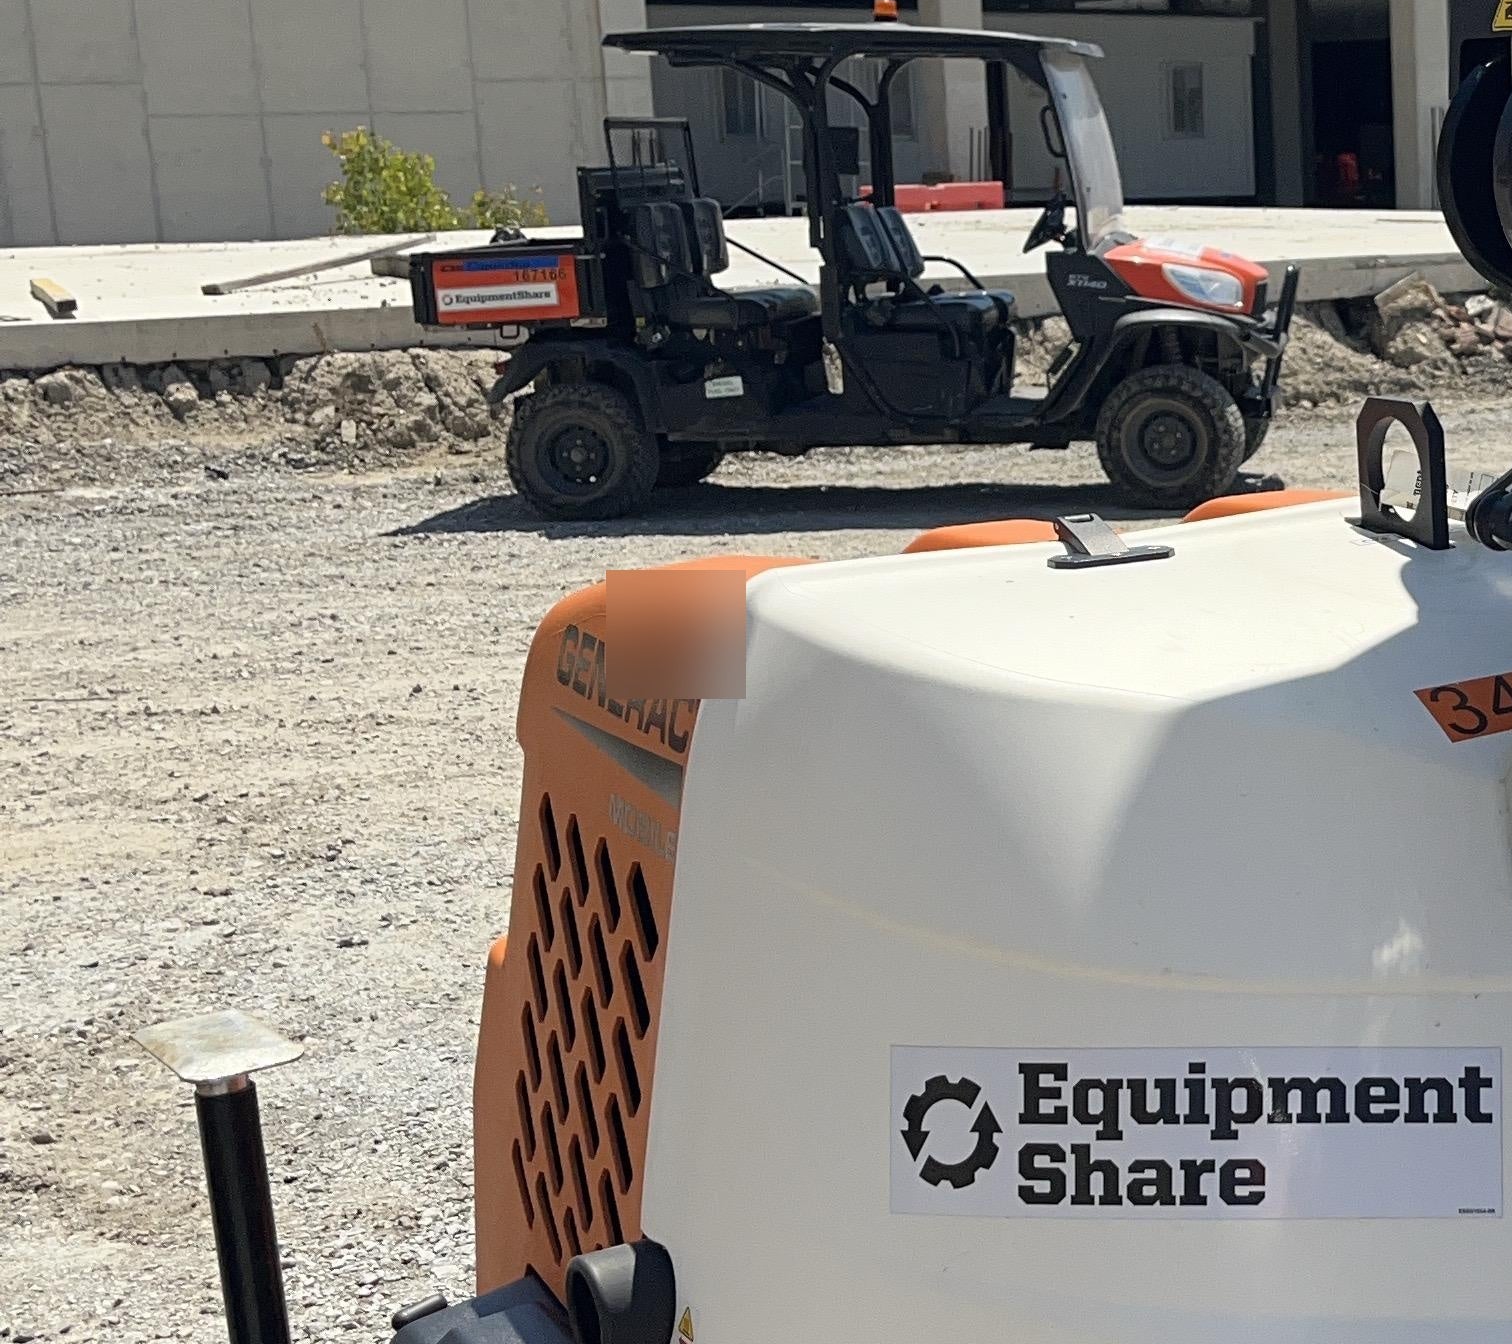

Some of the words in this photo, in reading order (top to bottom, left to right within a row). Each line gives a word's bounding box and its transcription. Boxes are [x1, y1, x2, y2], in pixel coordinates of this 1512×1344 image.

[455, 289, 552, 307] EquipmentShare
[556, 622, 698, 755] GENRAC
[1017, 1061, 1494, 1142] Equipment
[1017, 1142, 1267, 1207] Share
